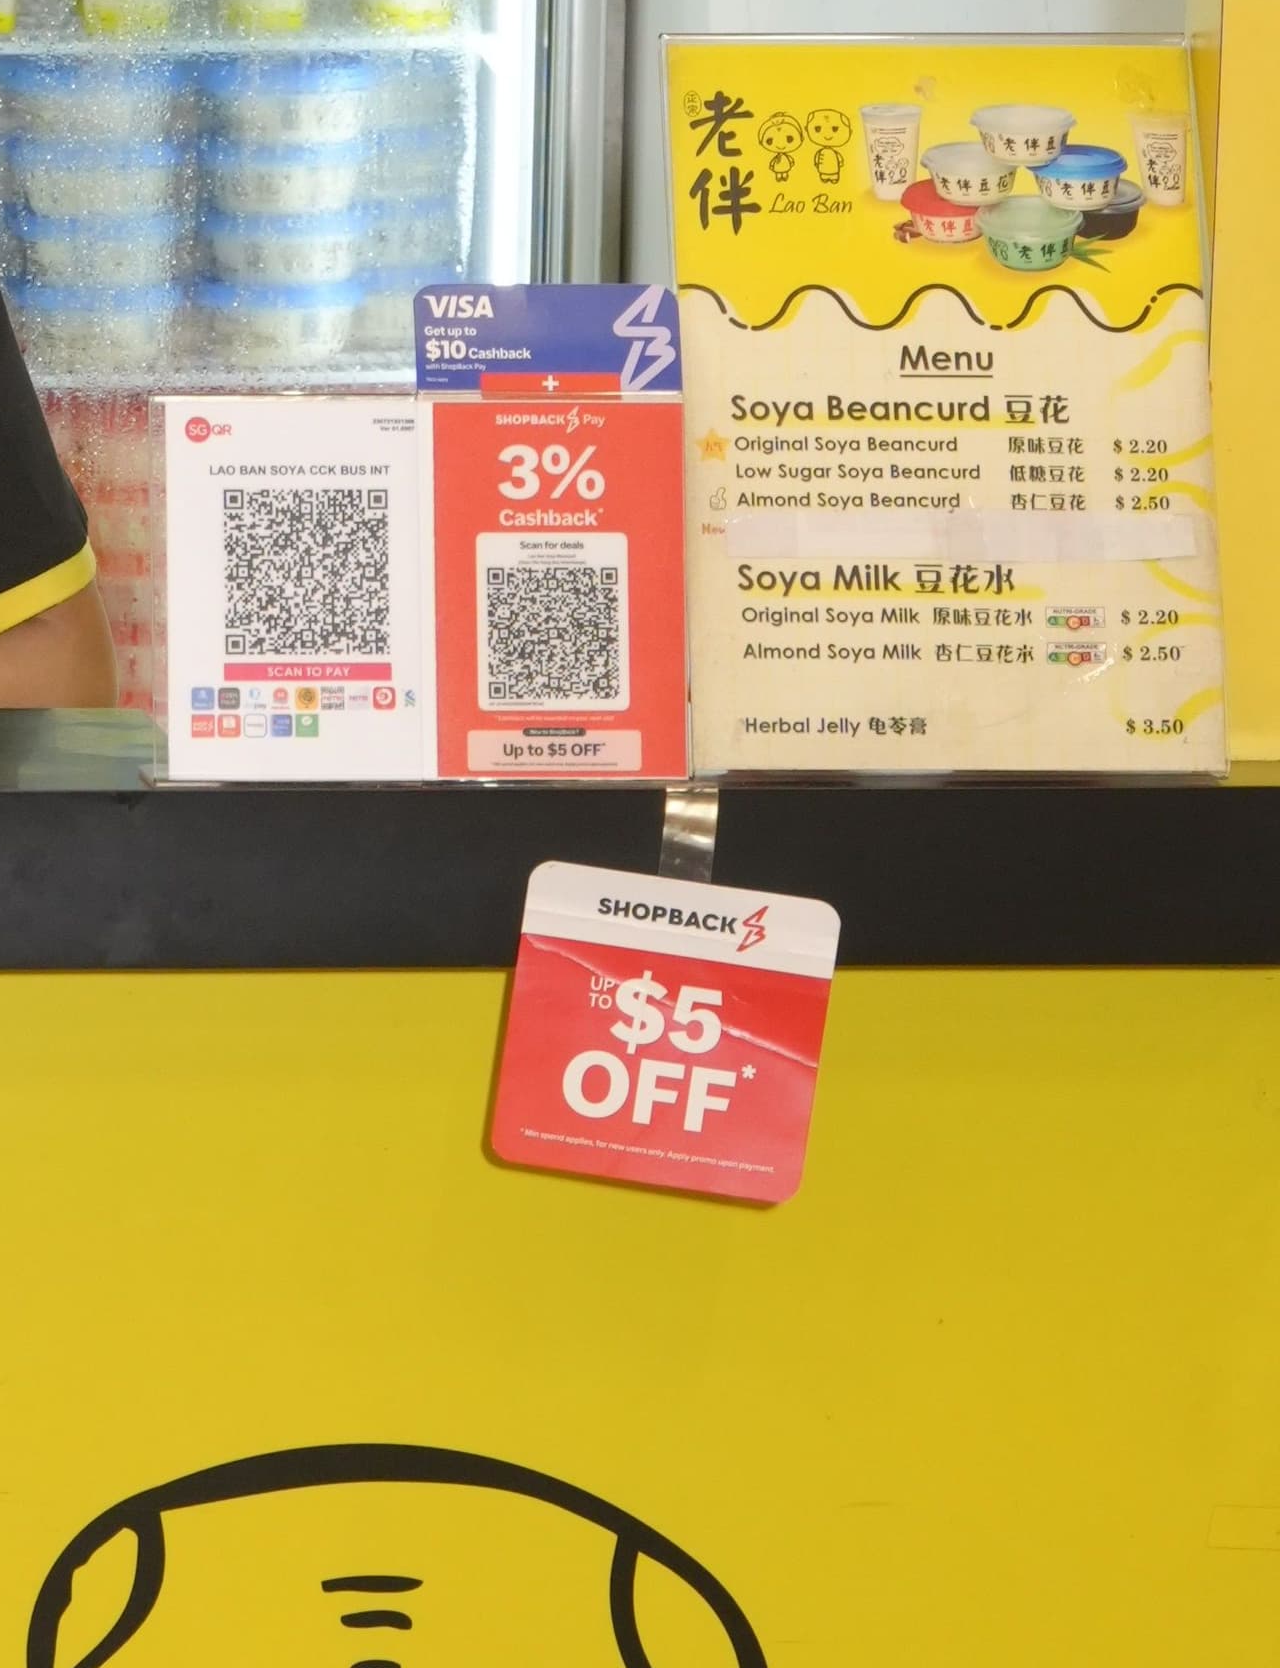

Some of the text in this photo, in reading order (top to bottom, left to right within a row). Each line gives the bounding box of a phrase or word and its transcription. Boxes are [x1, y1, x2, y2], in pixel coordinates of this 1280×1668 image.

[689, 90, 762, 236] 老伴
[768, 192, 853, 214] Lao Ban
[422, 294, 494, 319] VISA
[424, 326, 477, 338] Get up to
[425, 338, 532, 362] $10 Cashback
[899, 344, 994, 372] Menu
[495, 413, 606, 427] SHOPBACK Pay
[730, 393, 1070, 427] Soya Beancurd 豆花
[734, 435, 1085, 456] Original Soya Beancurd 原味豆花
[209, 465, 390, 476] LAO BAN SOYA CCK BUS INT
[497, 443, 606, 501] 3%
[736, 464, 1086, 484] Low Sugar Soya Beancurd 低糖豆花
[737, 492, 1087, 512] Almond Soya Beancurd 杏仁豆花
[519, 540, 584, 550] Scan for deals
[737, 564, 1016, 597] Soya Milk 豆花水
[742, 606, 1033, 627] Original Soya Milk 原味豆花水
[743, 644, 821, 660] Almond
[827, 644, 875, 663] Soya
[882, 643, 922, 661] Milk
[267, 666, 351, 678] SCAN TO PAY
[745, 716, 810, 733] Herbal
[817, 716, 861, 737] Jelly
[503, 741, 567, 760] Up to $5
[597, 897, 740, 935] SHOPBACK
[590, 975, 615, 993] UP
[588, 992, 613, 1010] TO
[609, 970, 724, 1055] $5
